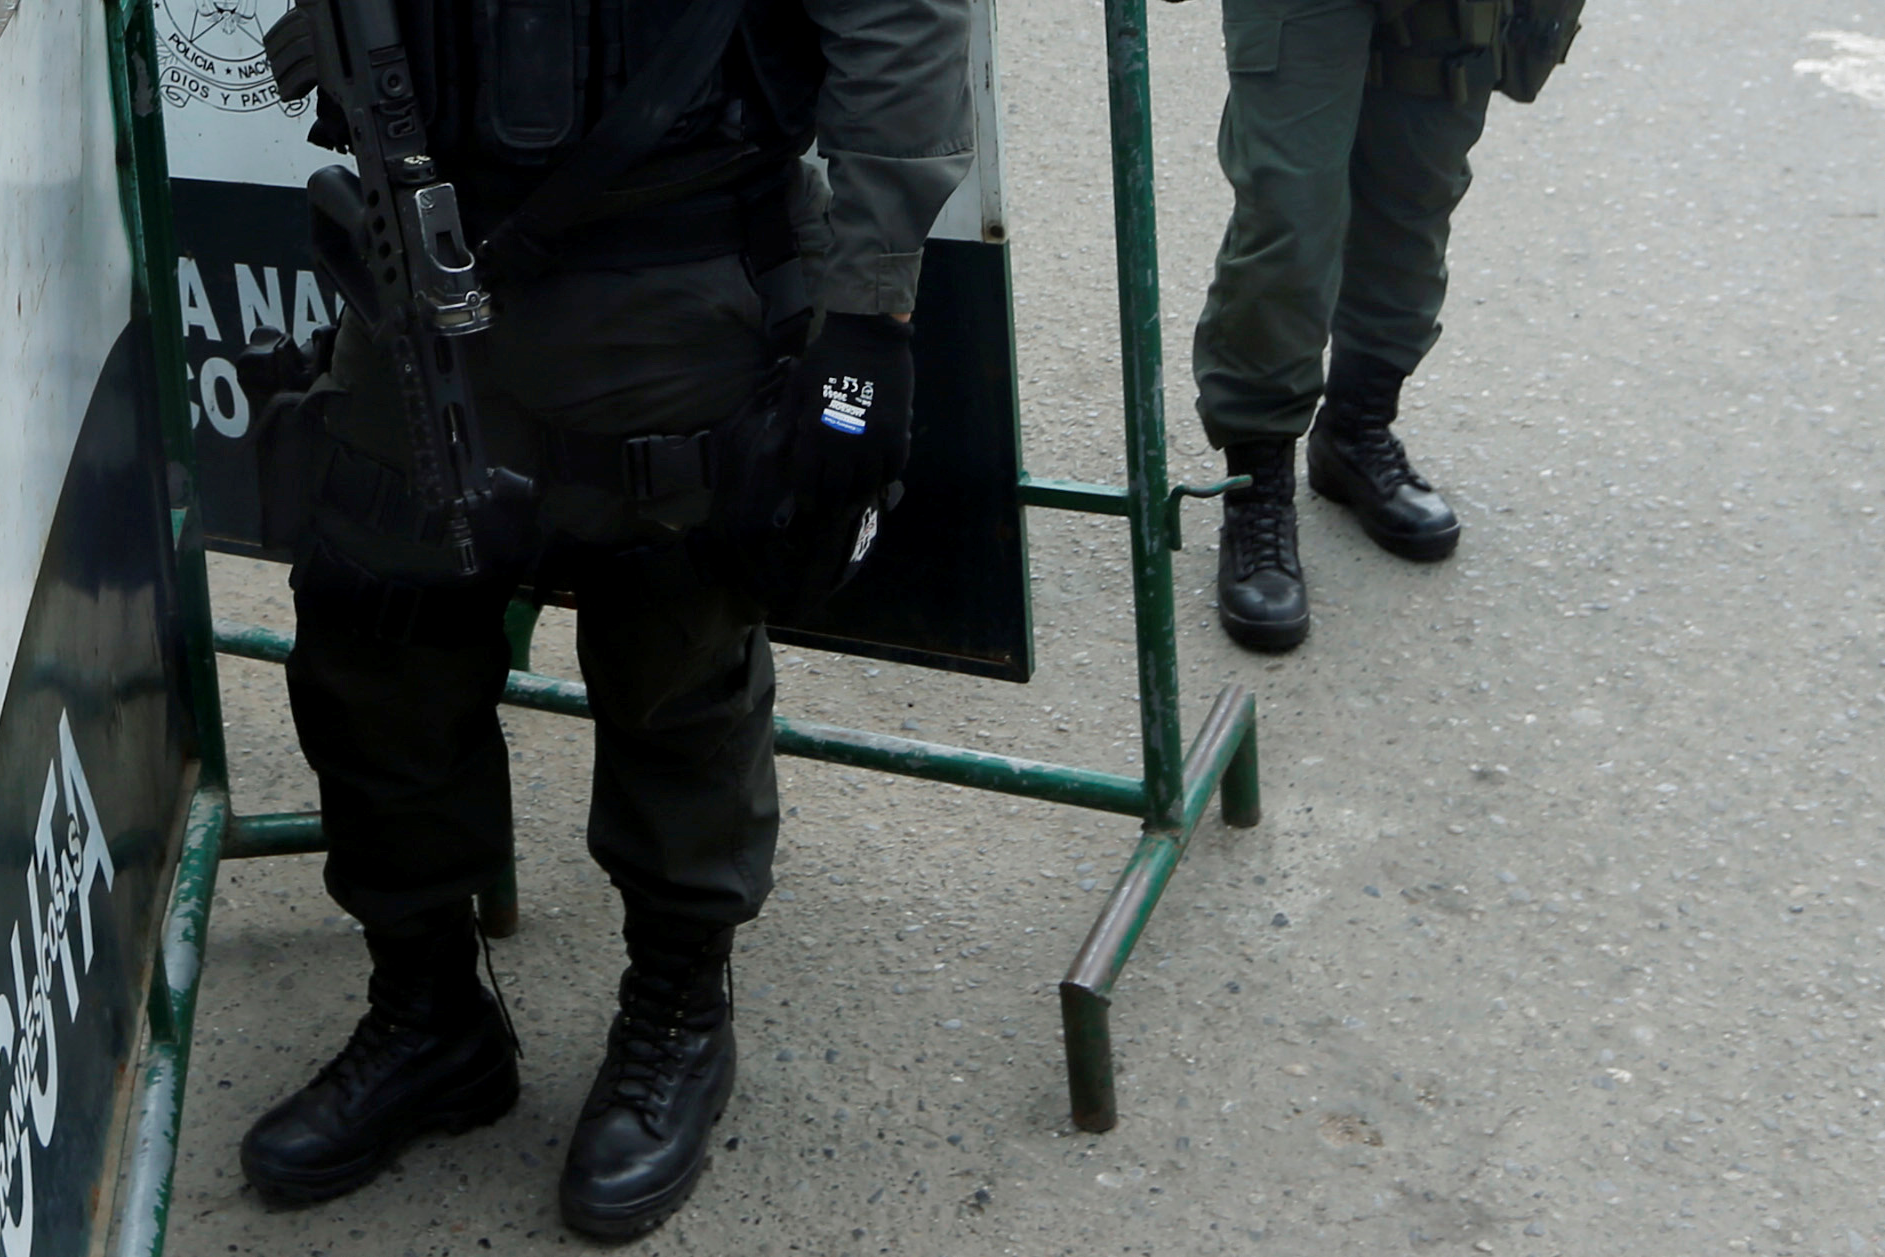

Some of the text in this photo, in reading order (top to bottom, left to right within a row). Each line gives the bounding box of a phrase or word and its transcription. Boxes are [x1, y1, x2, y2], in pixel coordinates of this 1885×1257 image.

[168, 32, 216, 75] POLICIA
[170, 70, 278, 108] DIOS Y PATR
[40, 812, 85, 1002] COSAS
